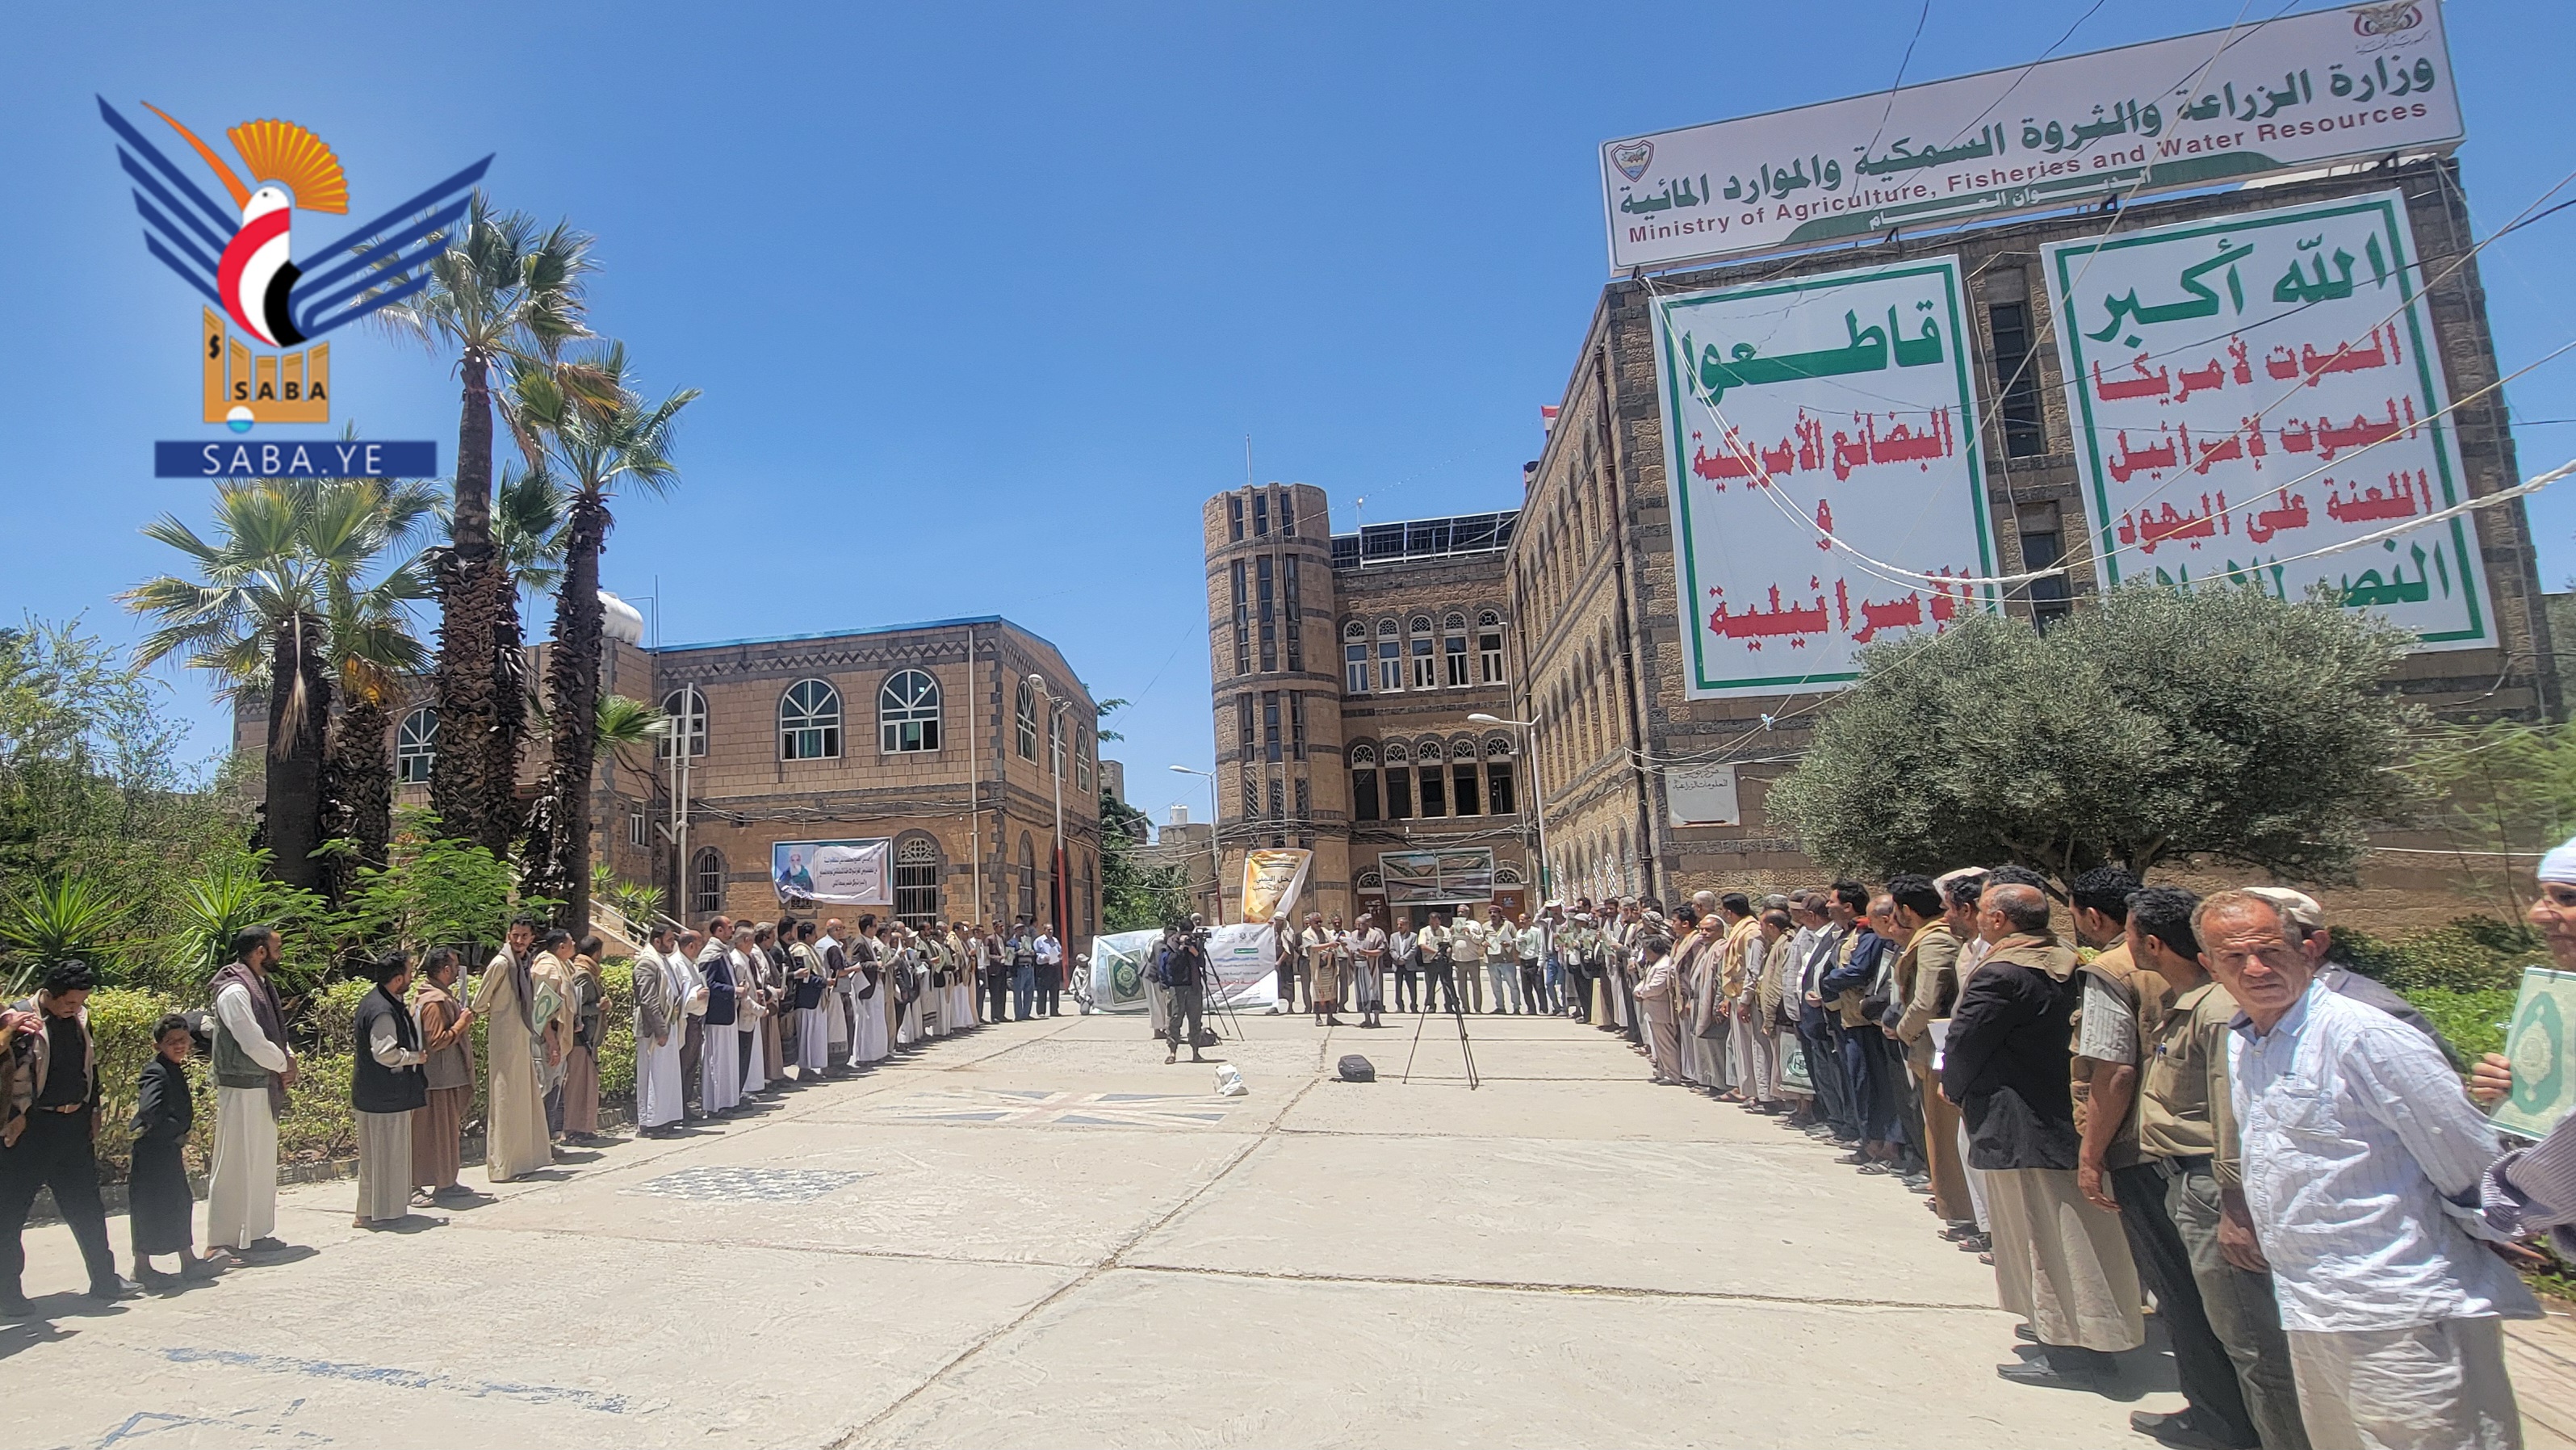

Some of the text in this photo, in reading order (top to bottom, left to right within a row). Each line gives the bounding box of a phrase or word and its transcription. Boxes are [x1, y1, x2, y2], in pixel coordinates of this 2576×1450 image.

[1619, 54, 2435, 221] وزارة الزراعة والثروة السمكية والموارد المائية
[1629, 103, 2428, 243] Ministry of Agriculture, Fisheries and Water Resources
[2084, 231, 2387, 349] الله أكبر
[1682, 298, 1946, 409] قاطعوا
[2092, 321, 2401, 406] الموت لأمريكا
[1693, 404, 1954, 494] البضائع الأمريكية
[2109, 394, 2418, 484] الموت لإسرائيل
[1816, 498, 1833, 551] و
[2117, 468, 2432, 555] اللعنة على اليهود
[1708, 564, 1975, 652] الإسرائيلية
[2340, 538, 2451, 609] النص
